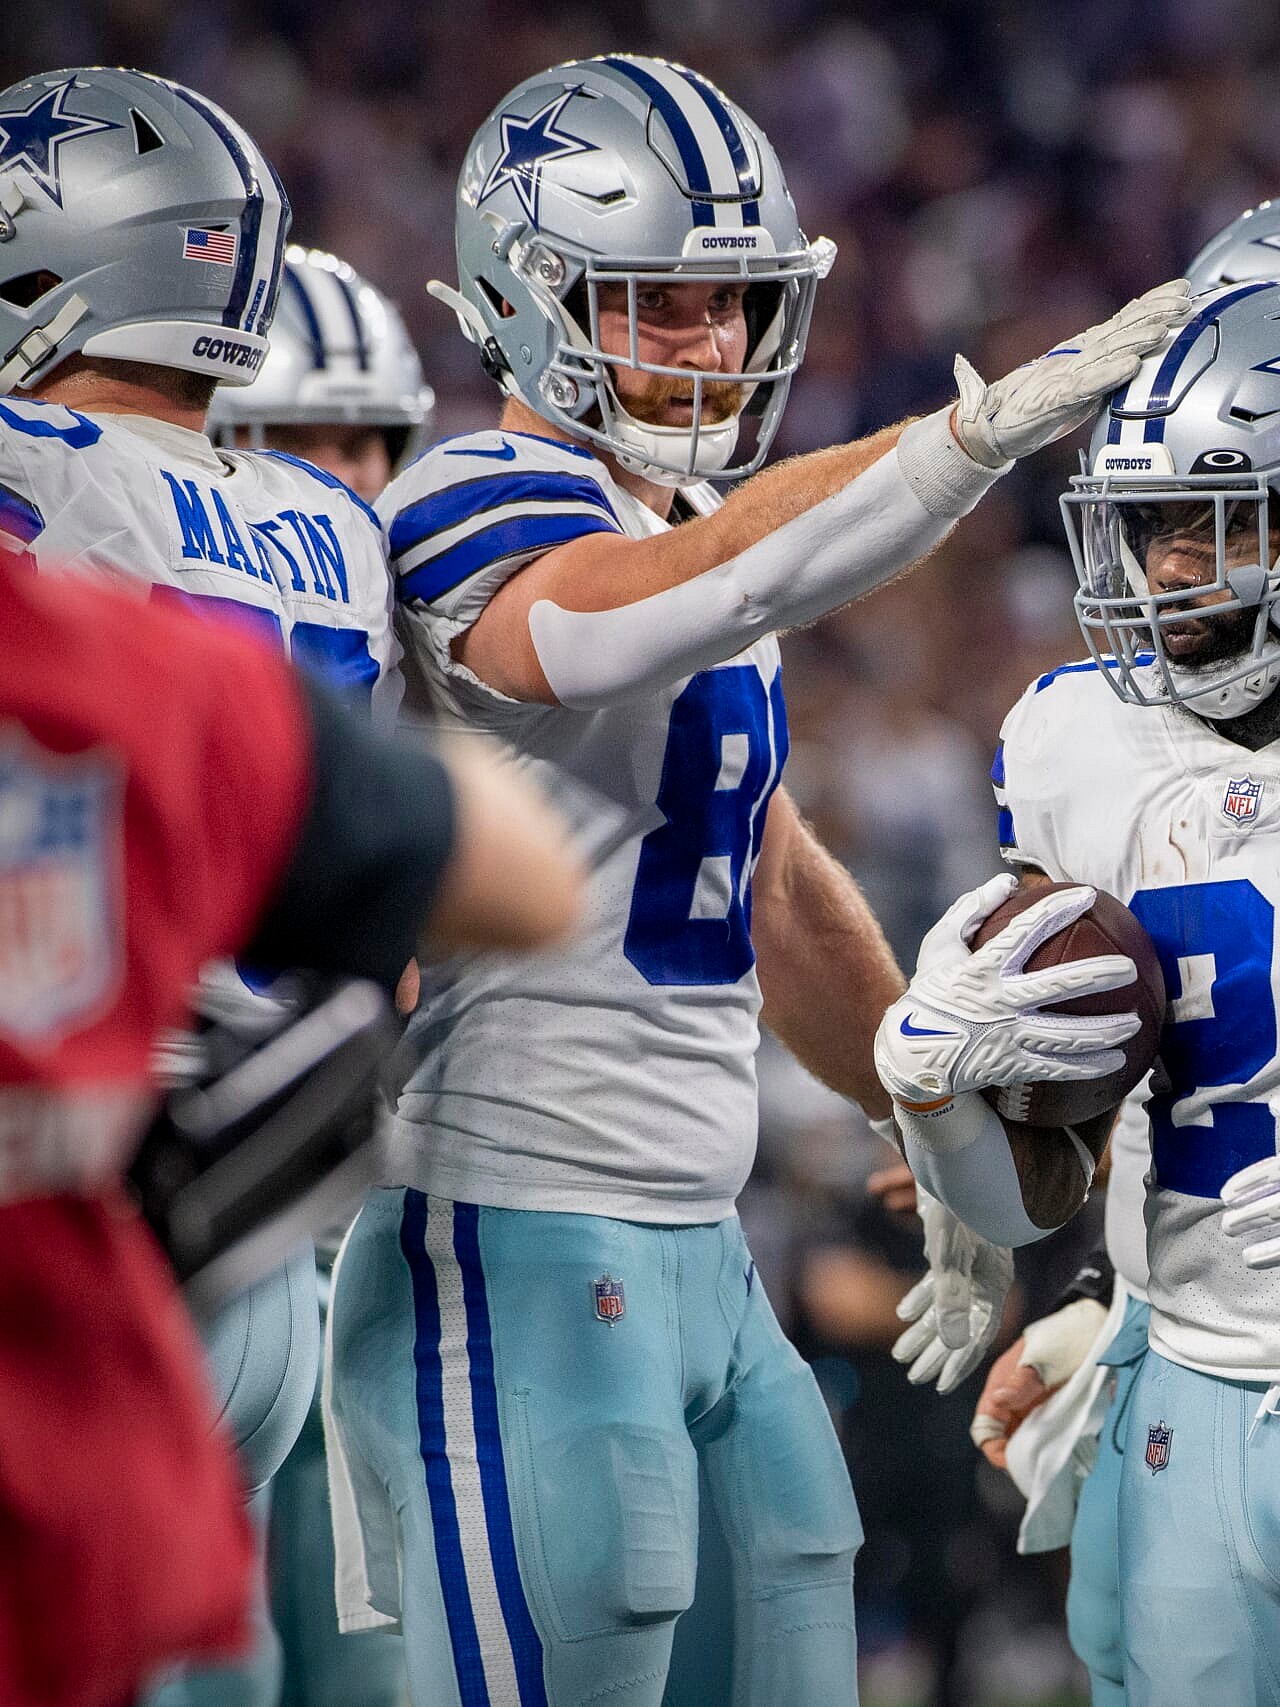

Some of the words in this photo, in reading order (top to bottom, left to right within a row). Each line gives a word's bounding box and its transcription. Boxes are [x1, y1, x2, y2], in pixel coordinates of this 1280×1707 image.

[702, 237, 757, 249] COWBOYS
[192, 336, 264, 371] COWBOY
[1105, 458, 1152, 471] COWBOYS
[1226, 795, 1253, 817] NFL
[624, 664, 791, 987] 8
[600, 1297, 623, 1316] NFL
[1148, 1443, 1165, 1464] NFL
